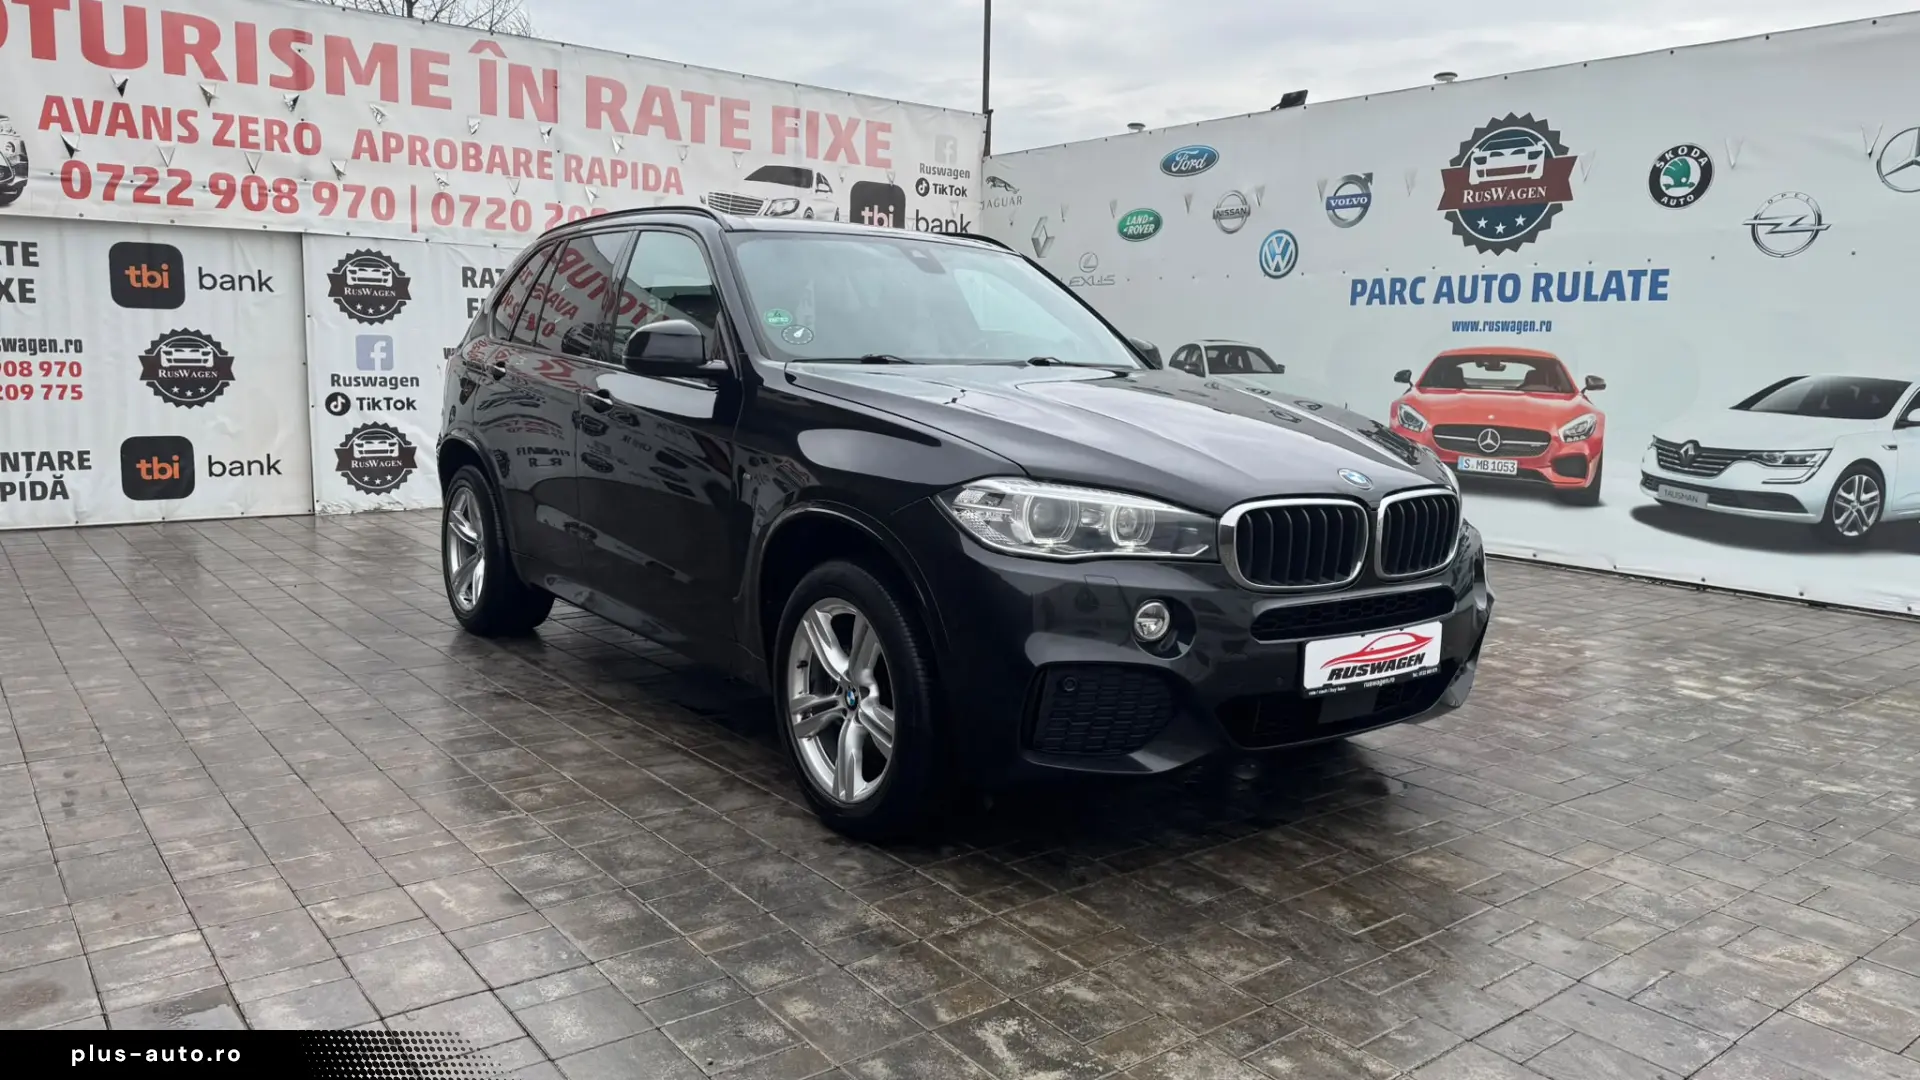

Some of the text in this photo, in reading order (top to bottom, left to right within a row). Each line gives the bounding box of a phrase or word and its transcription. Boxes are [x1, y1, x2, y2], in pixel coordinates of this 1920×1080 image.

[0, 0, 893, 169] TURISME ÎN RATE FIXE
[38, 94, 685, 196] AVANS ZERO APROBARE RAPIDA
[1171, 149, 1206, 172] Ford
[919, 162, 971, 180] Ruswagen
[60, 159, 194, 207] 0722
[208, 172, 300, 215] 908
[311, 181, 396, 221] 970
[430, 191, 533, 233] 0720
[932, 182, 968, 198] TikTok
[1330, 195, 1369, 207] VOLVO
[1660, 194, 1696, 206] AUTO
[861, 204, 972, 234] tbi bank
[1215, 206, 1248, 218] NISSAN
[0, 240, 40, 267] TE
[125, 263, 275, 293] tbi bank
[1060, 275, 1116, 287] EXUS
[1349, 267, 1671, 307] PARC AUTO RULATE
[1452, 320, 1553, 335] www.ruswagen.ro
[0, 360, 83, 378] 08 970
[330, 373, 420, 390] Ruswagen
[40, 383, 84, 401] 775
[356, 396, 418, 411] TikTok
[135, 453, 283, 481] tbi bank
[1491, 461, 1516, 473] 1053
[1327, 652, 1426, 682] RUSWAGEN
